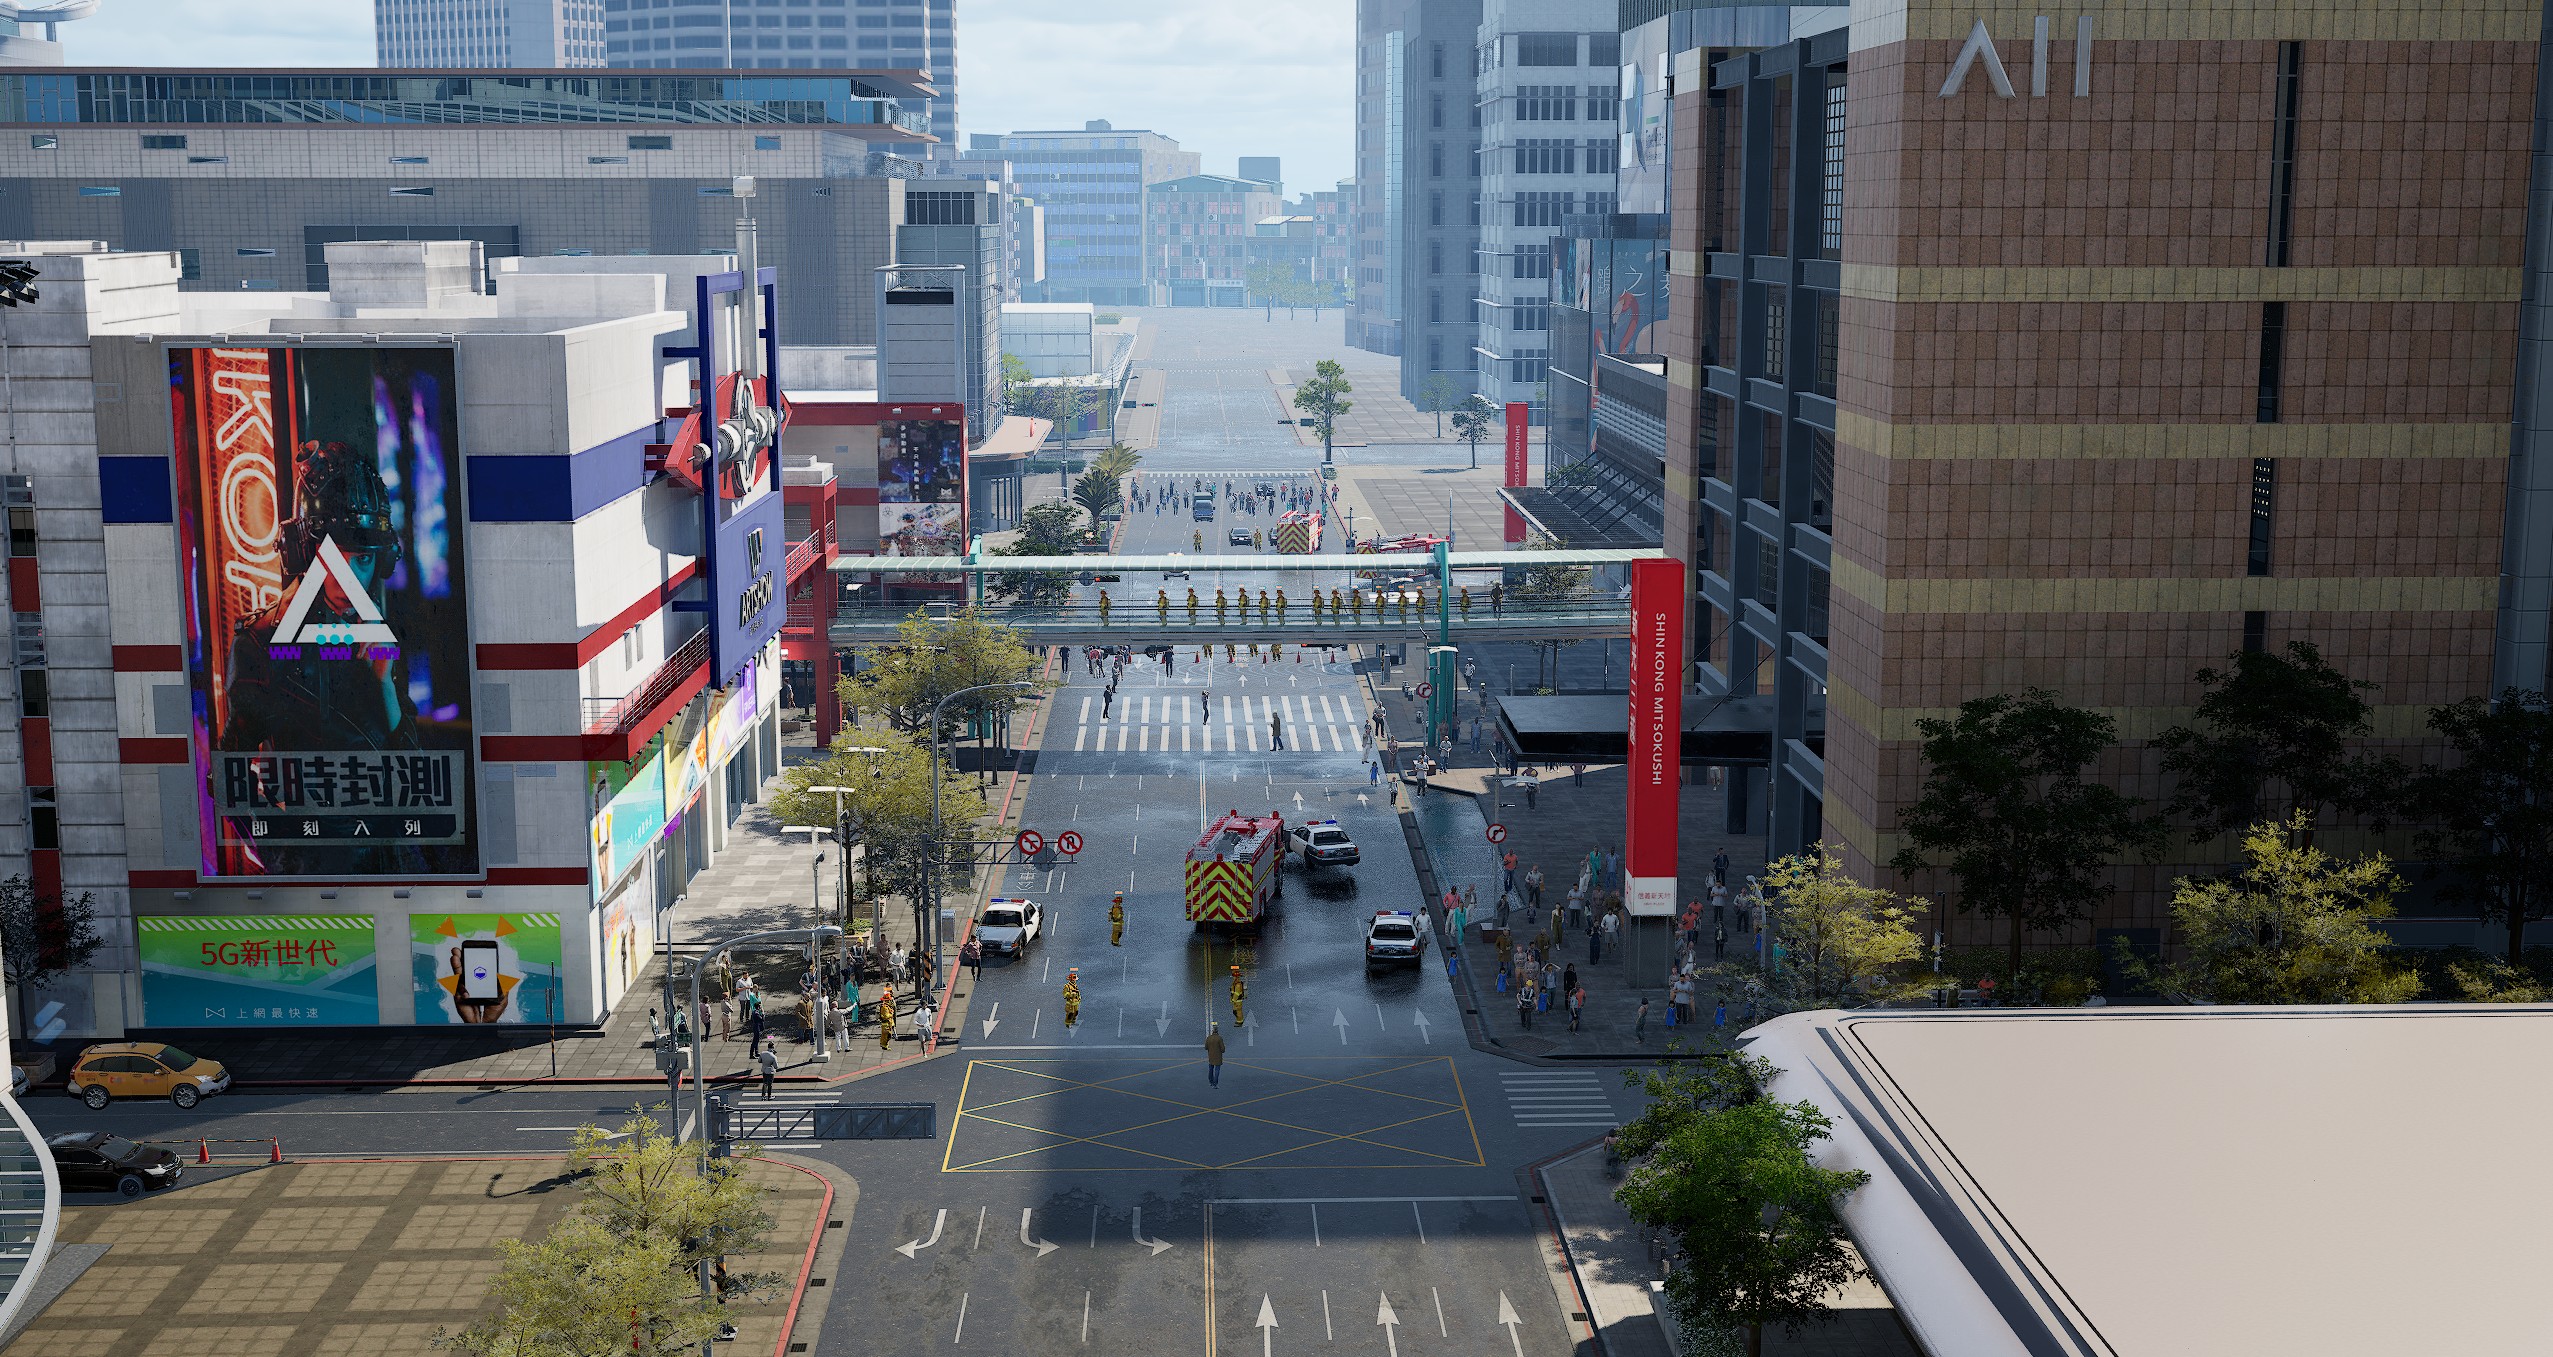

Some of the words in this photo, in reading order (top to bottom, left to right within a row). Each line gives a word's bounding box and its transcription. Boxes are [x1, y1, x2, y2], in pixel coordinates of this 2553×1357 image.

[1655, 613, 1666, 648] SHIN
[1654, 651, 1665, 692] KONG
[1652, 698, 1664, 785] MITSOKUSHI
[224, 755, 452, 808] 限時封測
[251, 820, 421, 837] 即刻入列
[201, 939, 338, 968] 5G新世代
[235, 1007, 319, 1020] 上網最快速
